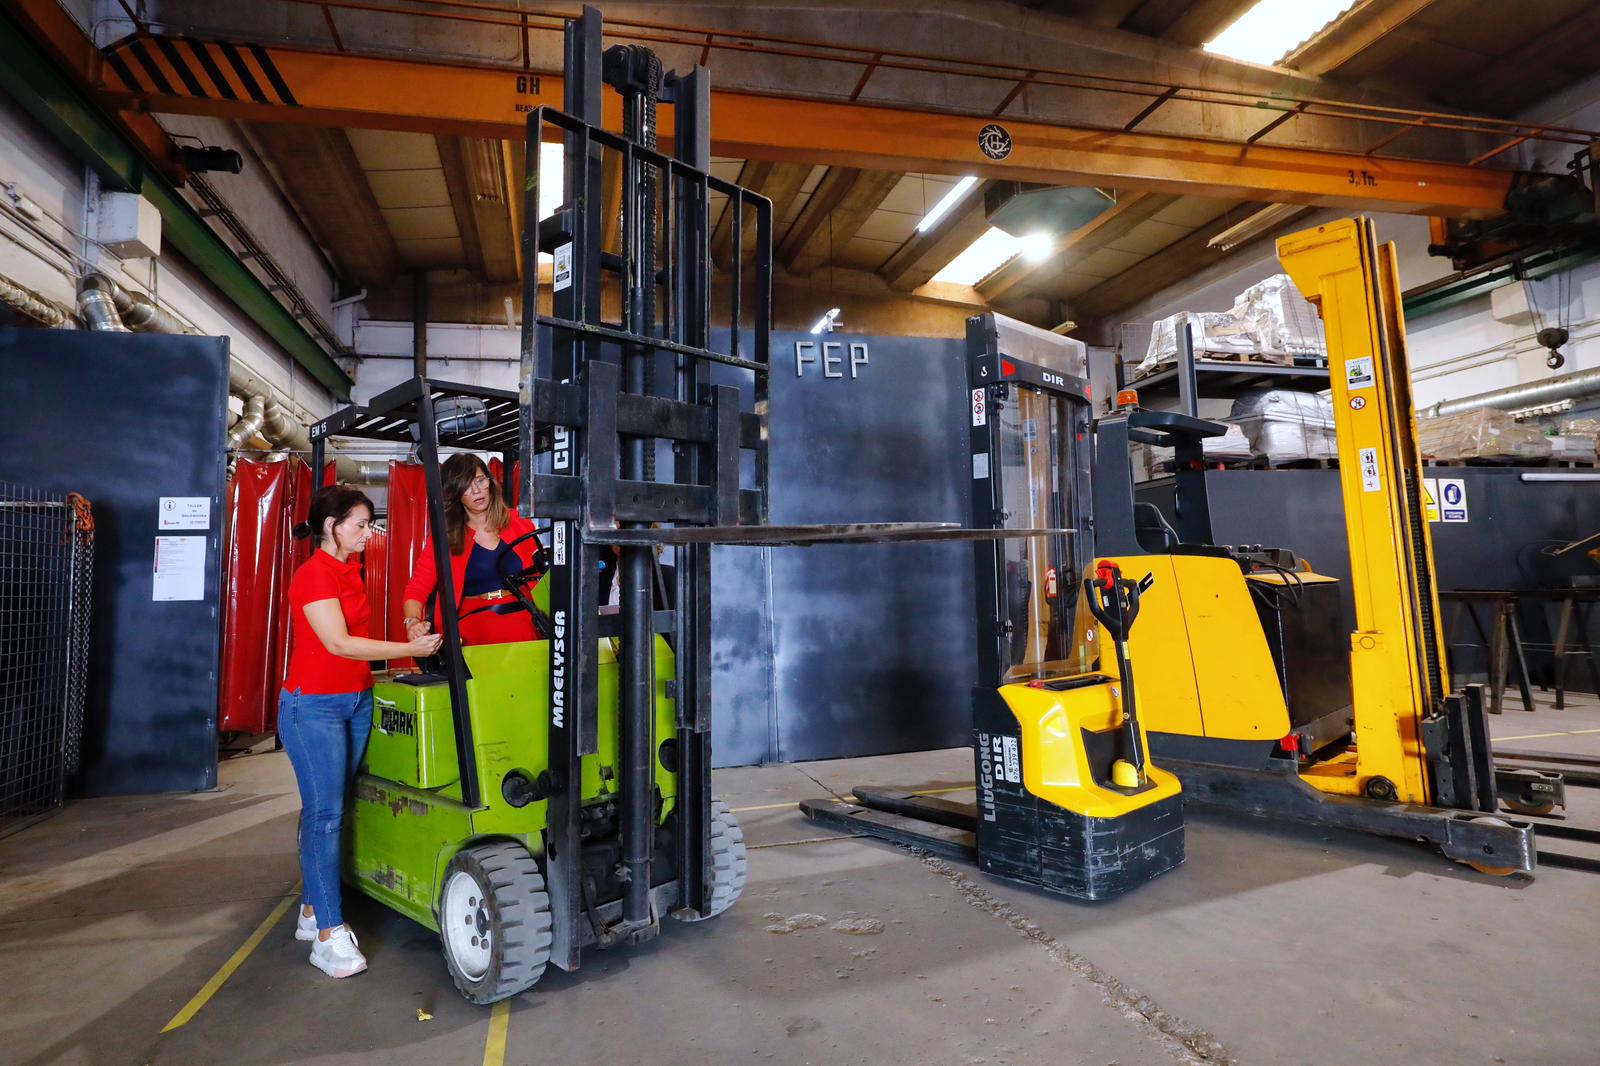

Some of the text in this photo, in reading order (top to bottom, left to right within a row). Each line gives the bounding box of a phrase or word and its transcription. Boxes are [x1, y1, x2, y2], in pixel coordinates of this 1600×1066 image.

[516, 76, 540, 95] GH
[796, 342, 868, 378] FEP
[1042, 372, 1064, 386] DIR
[321, 422, 327, 433] 15
[553, 611, 565, 728] MAELYSER
[993, 737, 1004, 780] DIR
[979, 733, 996, 822] LIUGONG
